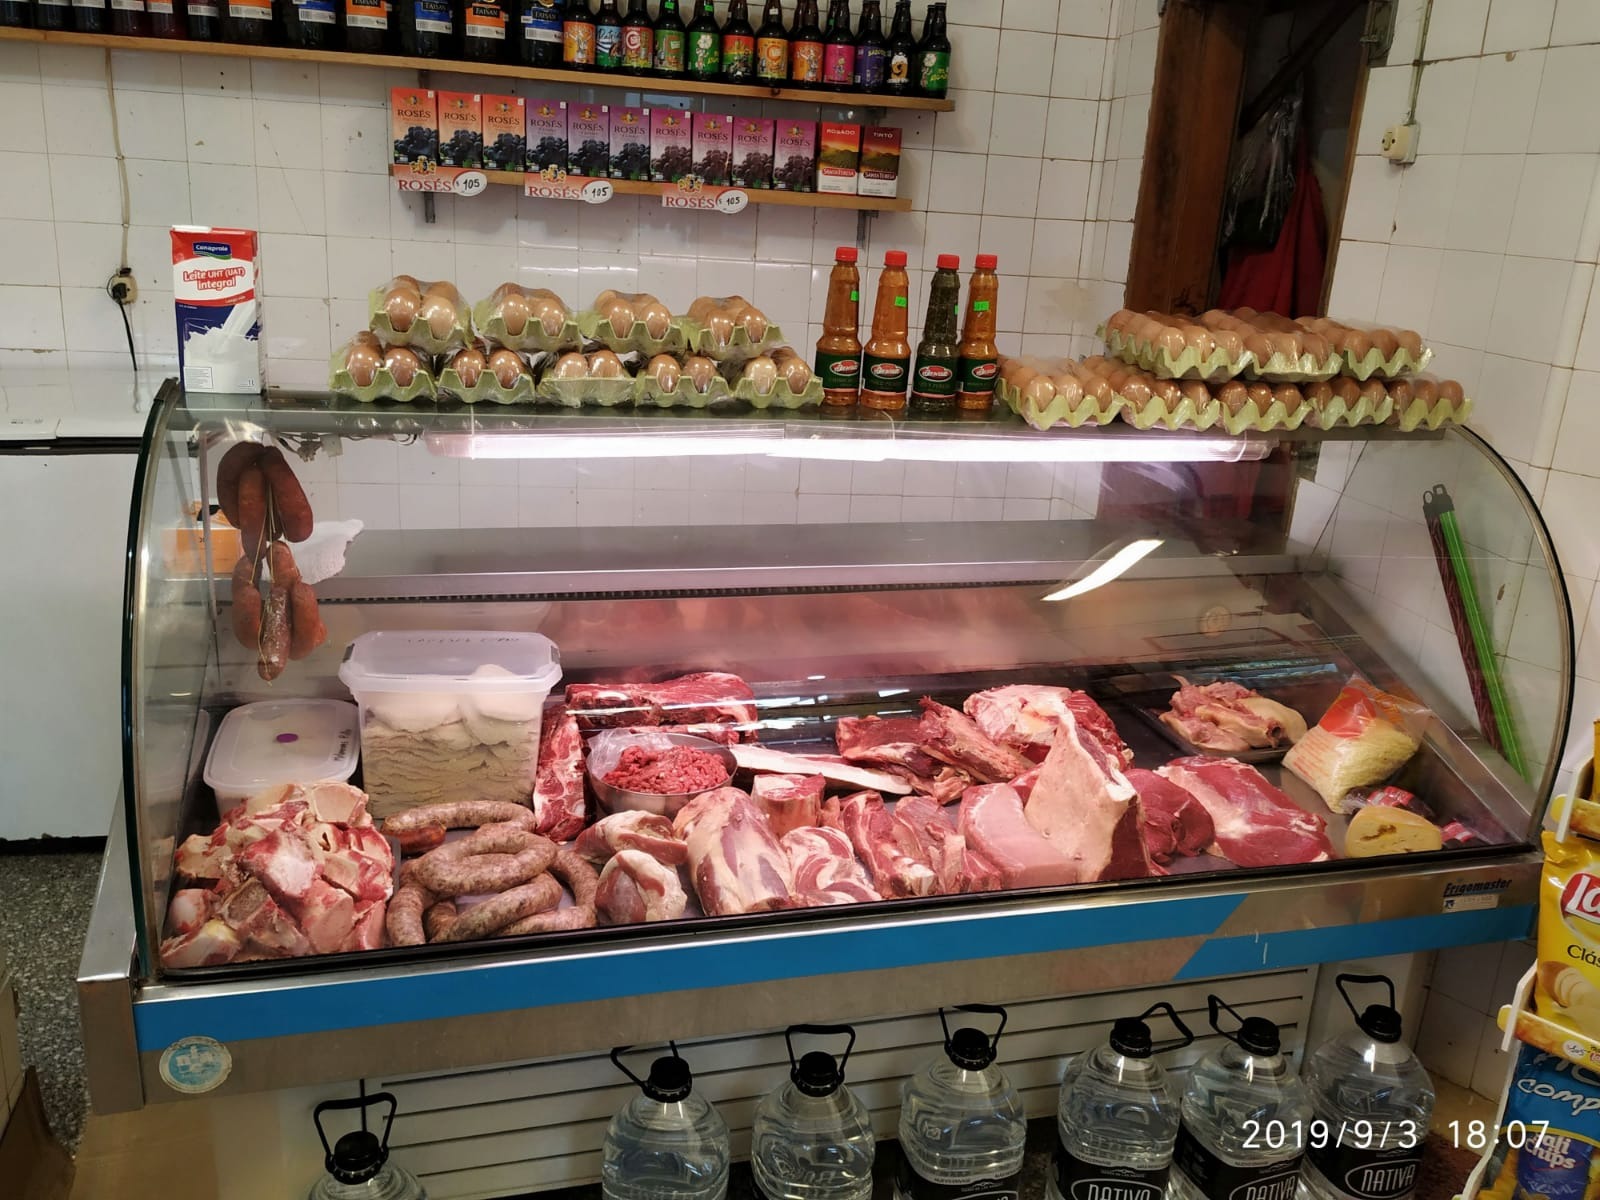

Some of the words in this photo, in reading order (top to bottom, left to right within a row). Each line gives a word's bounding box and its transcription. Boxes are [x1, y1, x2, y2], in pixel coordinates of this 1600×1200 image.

[398, 178, 452, 192] ROSÉS
[463, 178, 480, 190] 105
[528, 185, 581, 199] ROSÉS
[591, 186, 609, 198] 105
[665, 195, 716, 209] ROSÉS
[726, 196, 741, 206] 105
[184, 270, 206, 281] Leite
[207, 270, 224, 278] UHT
[1443, 878, 1513, 897] Frigomaster
[1361, 1164, 1416, 1192] NATIVA
